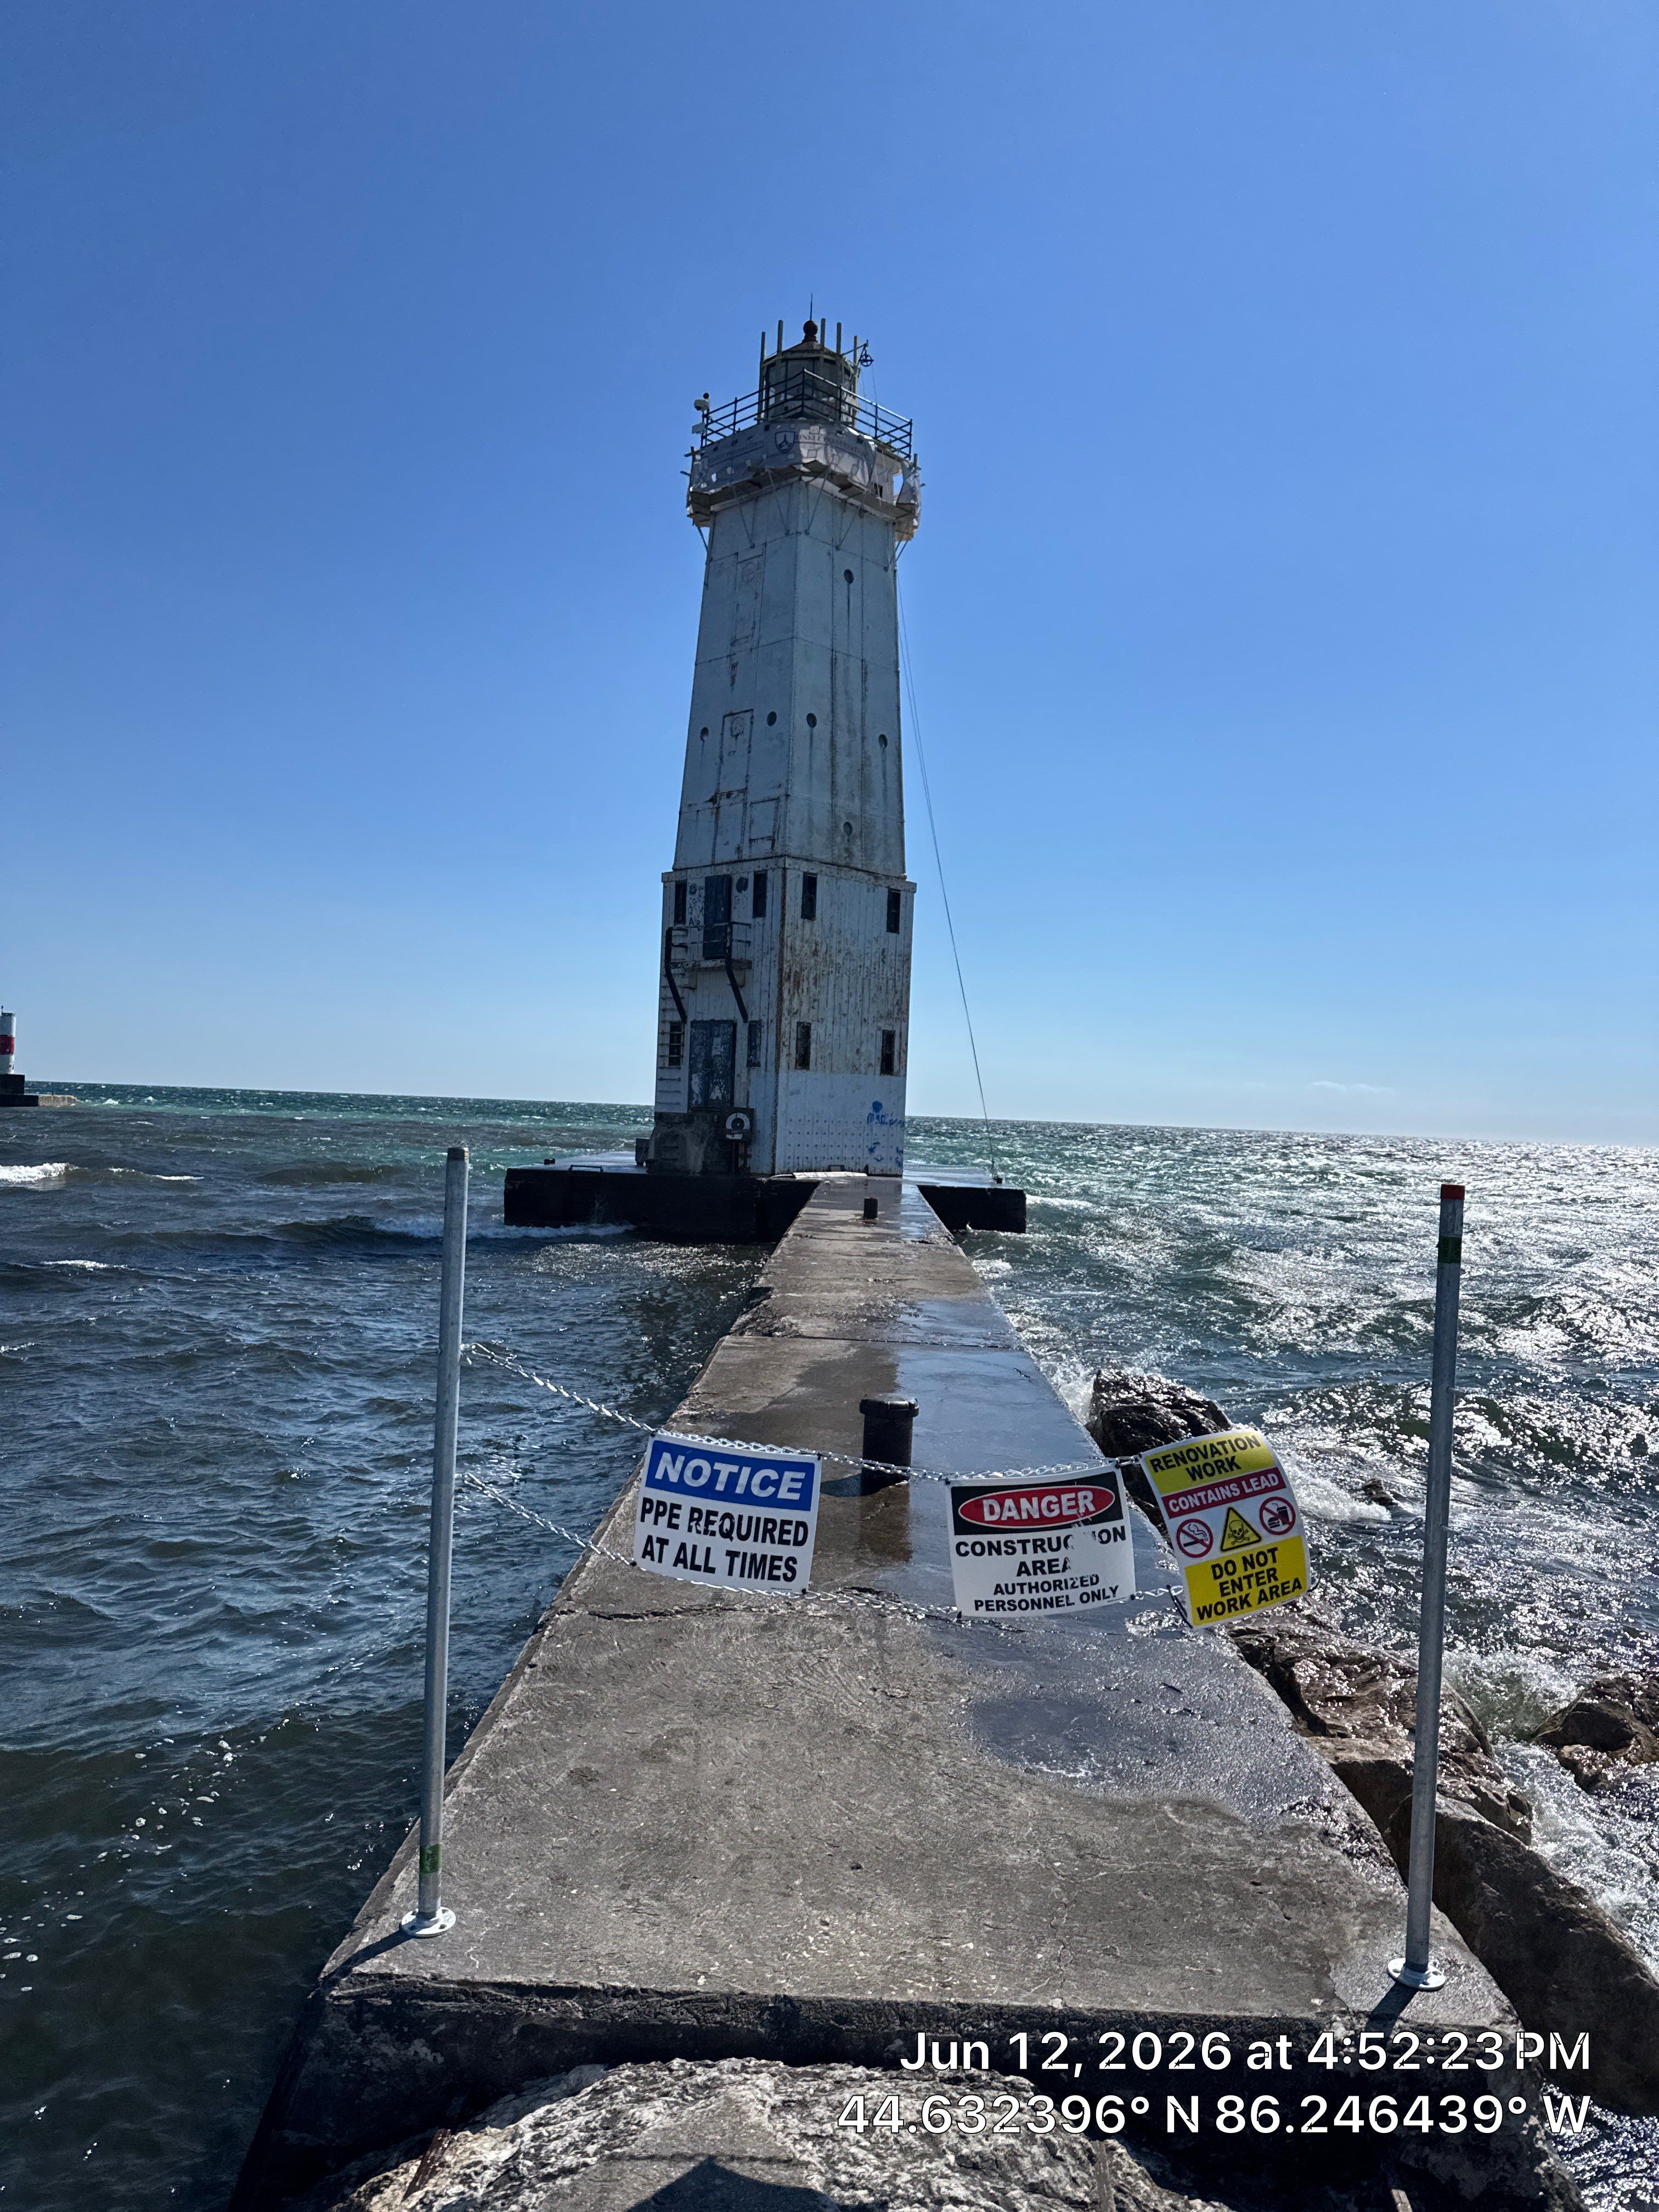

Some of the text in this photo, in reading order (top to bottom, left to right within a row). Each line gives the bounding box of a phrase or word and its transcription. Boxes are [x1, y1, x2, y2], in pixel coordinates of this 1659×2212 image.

[1150, 1435, 1261, 1473] RENOVATION
[1186, 1455, 1242, 1481] WORK
[655, 1452, 805, 1500] NOTICE
[983, 1490, 1096, 1521] DANGER
[1169, 1473, 1280, 1513] CONTAINS LEAD
[640, 1497, 809, 1547] PPE REQUIRED
[955, 1526, 1126, 1557] CONSTRUCON
[641, 1535, 798, 1583] AT ALL TIMES
[1211, 1547, 1279, 1580] DO NOT
[974, 1585, 1119, 1612] PERSONNEL ONLY
[994, 1573, 1099, 1595] AUTHORIZED
[1197, 1577, 1302, 1621] WORK AREA
[1219, 1567, 1278, 1598] ENTER
